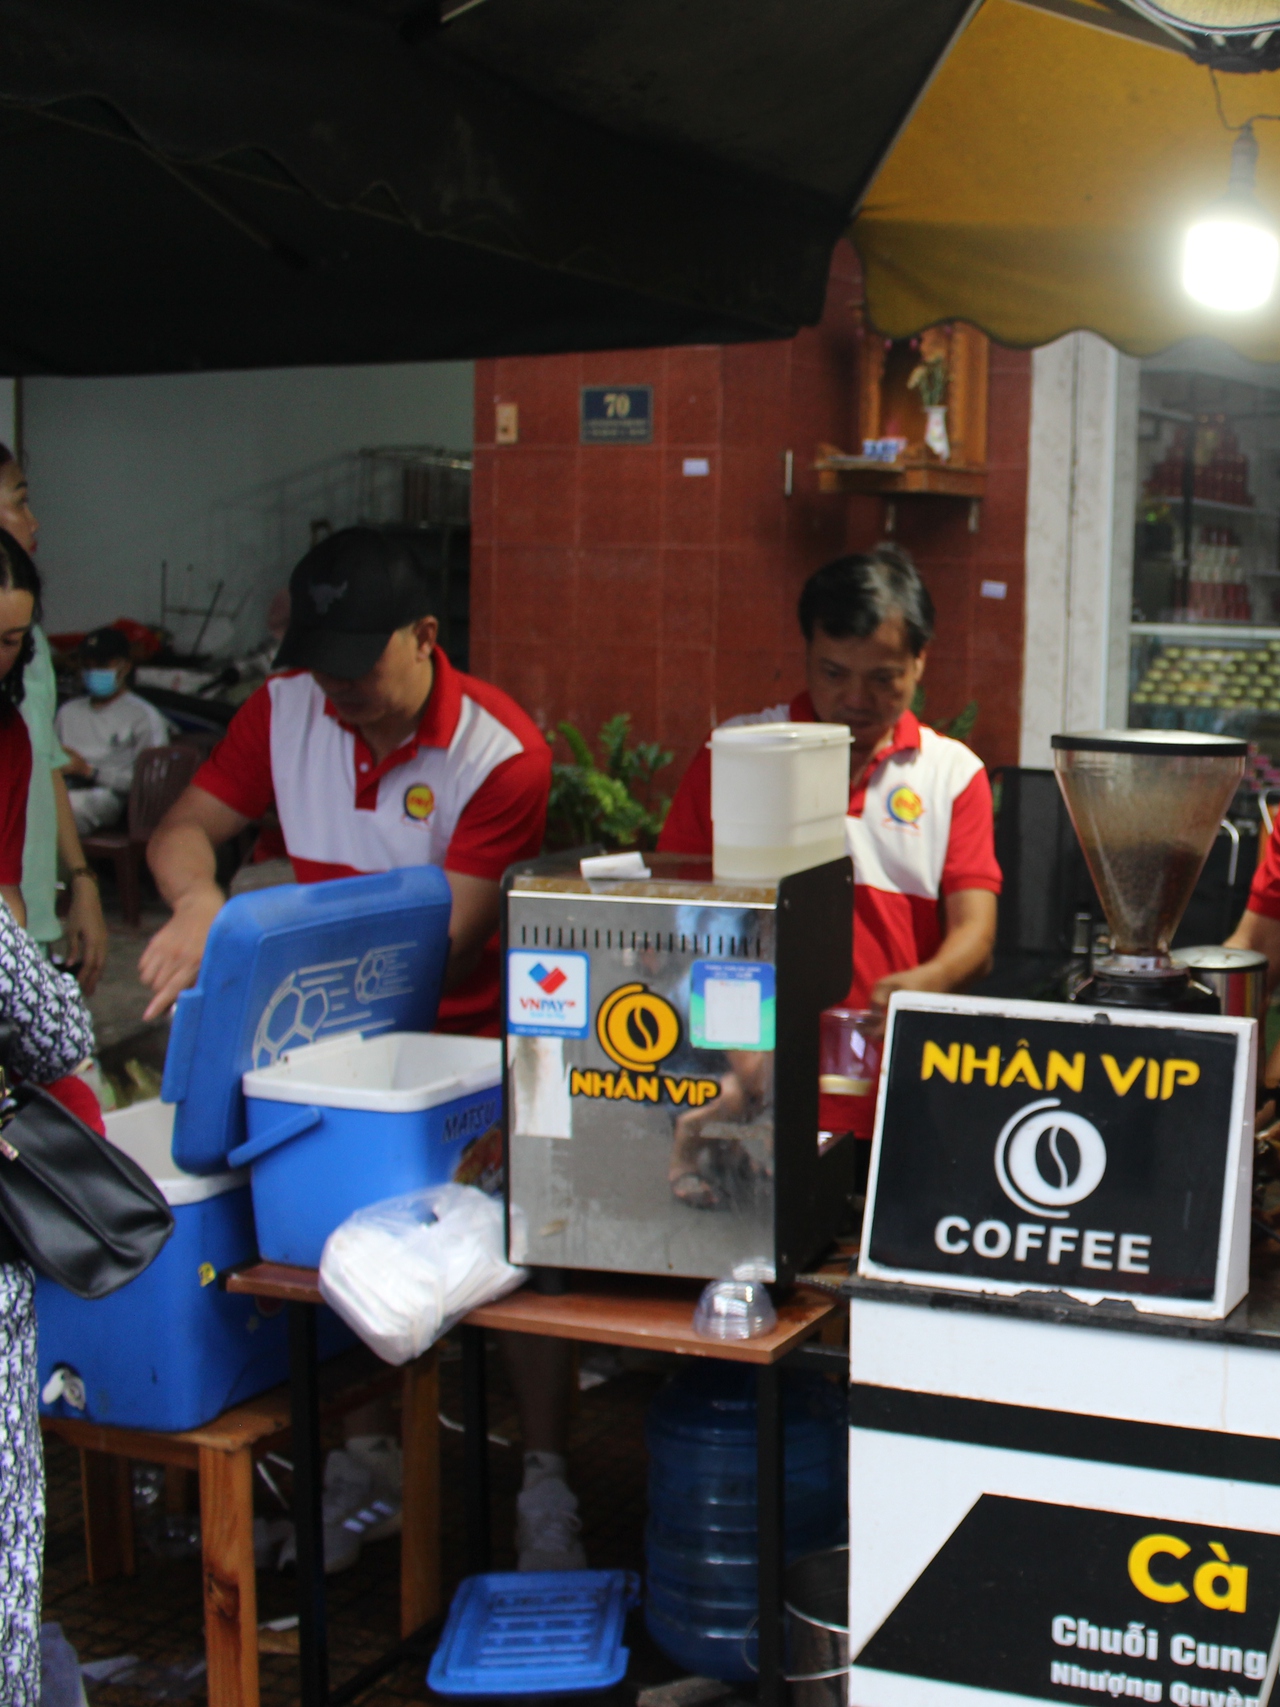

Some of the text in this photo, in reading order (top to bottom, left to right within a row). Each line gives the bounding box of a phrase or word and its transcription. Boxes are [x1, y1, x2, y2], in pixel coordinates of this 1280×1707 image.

[603, 393, 630, 417] 70
[571, 1068, 719, 1106] NHÂN VIP
[921, 1038, 1200, 1100] NHÂN VIP
[934, 1215, 1152, 1274] COFFEE
[1127, 1533, 1249, 1614] Cà
[1051, 1614, 1158, 1660] Chuỗi
[1170, 1634, 1268, 1680] Cung
[1051, 1661, 1163, 1702] Nhượng
